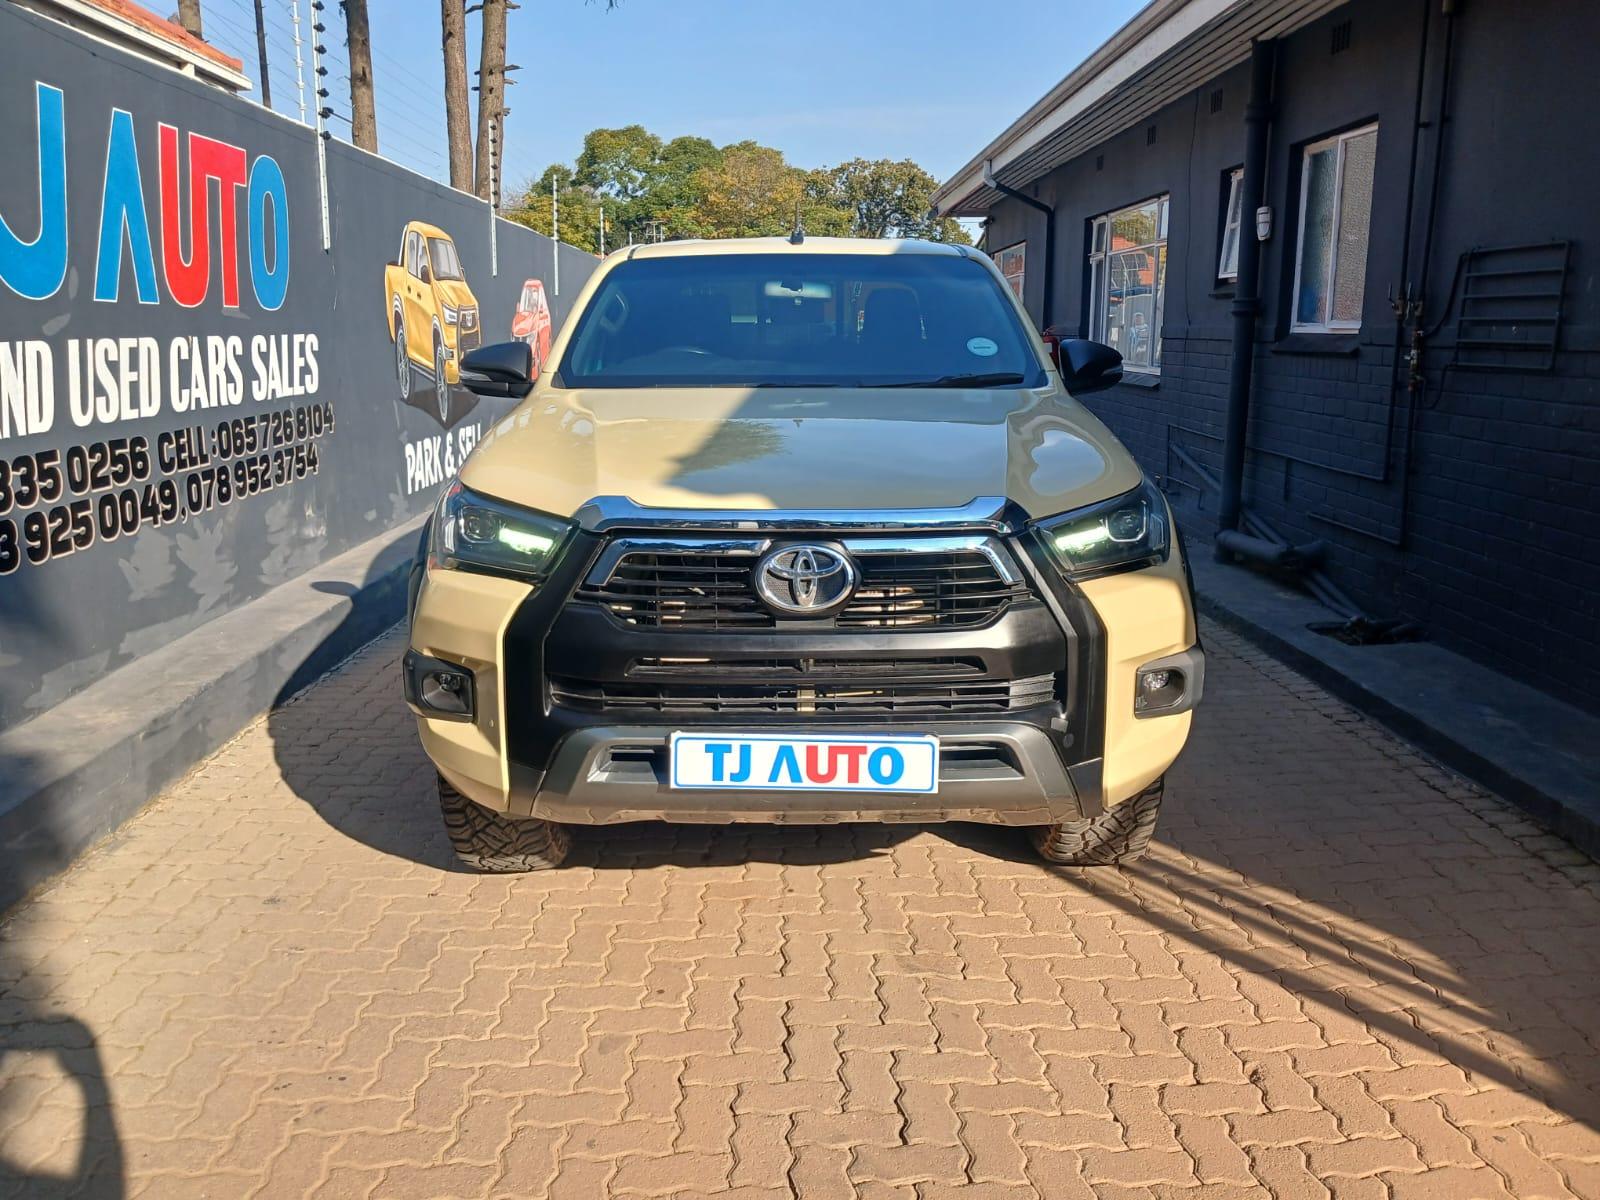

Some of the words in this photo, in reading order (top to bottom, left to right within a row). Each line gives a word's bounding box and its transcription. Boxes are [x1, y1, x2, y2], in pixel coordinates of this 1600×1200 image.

[93, 107, 289, 311] AUTO
[0, 339, 54, 439] ND
[67, 337, 161, 427] USED
[169, 335, 244, 413] CARS
[251, 333, 319, 402] SALES
[67, 436, 150, 496] 0256
[259, 409, 295, 451] 726
[296, 401, 336, 442] 8104
[405, 435, 443, 495] PARK
[444, 431, 457, 478] &
[23, 498, 95, 566] 925
[233, 454, 273, 500] 952
[274, 441, 320, 488] 3754
[705, 743, 752, 783] TJ
[767, 744, 905, 786] AUTO
